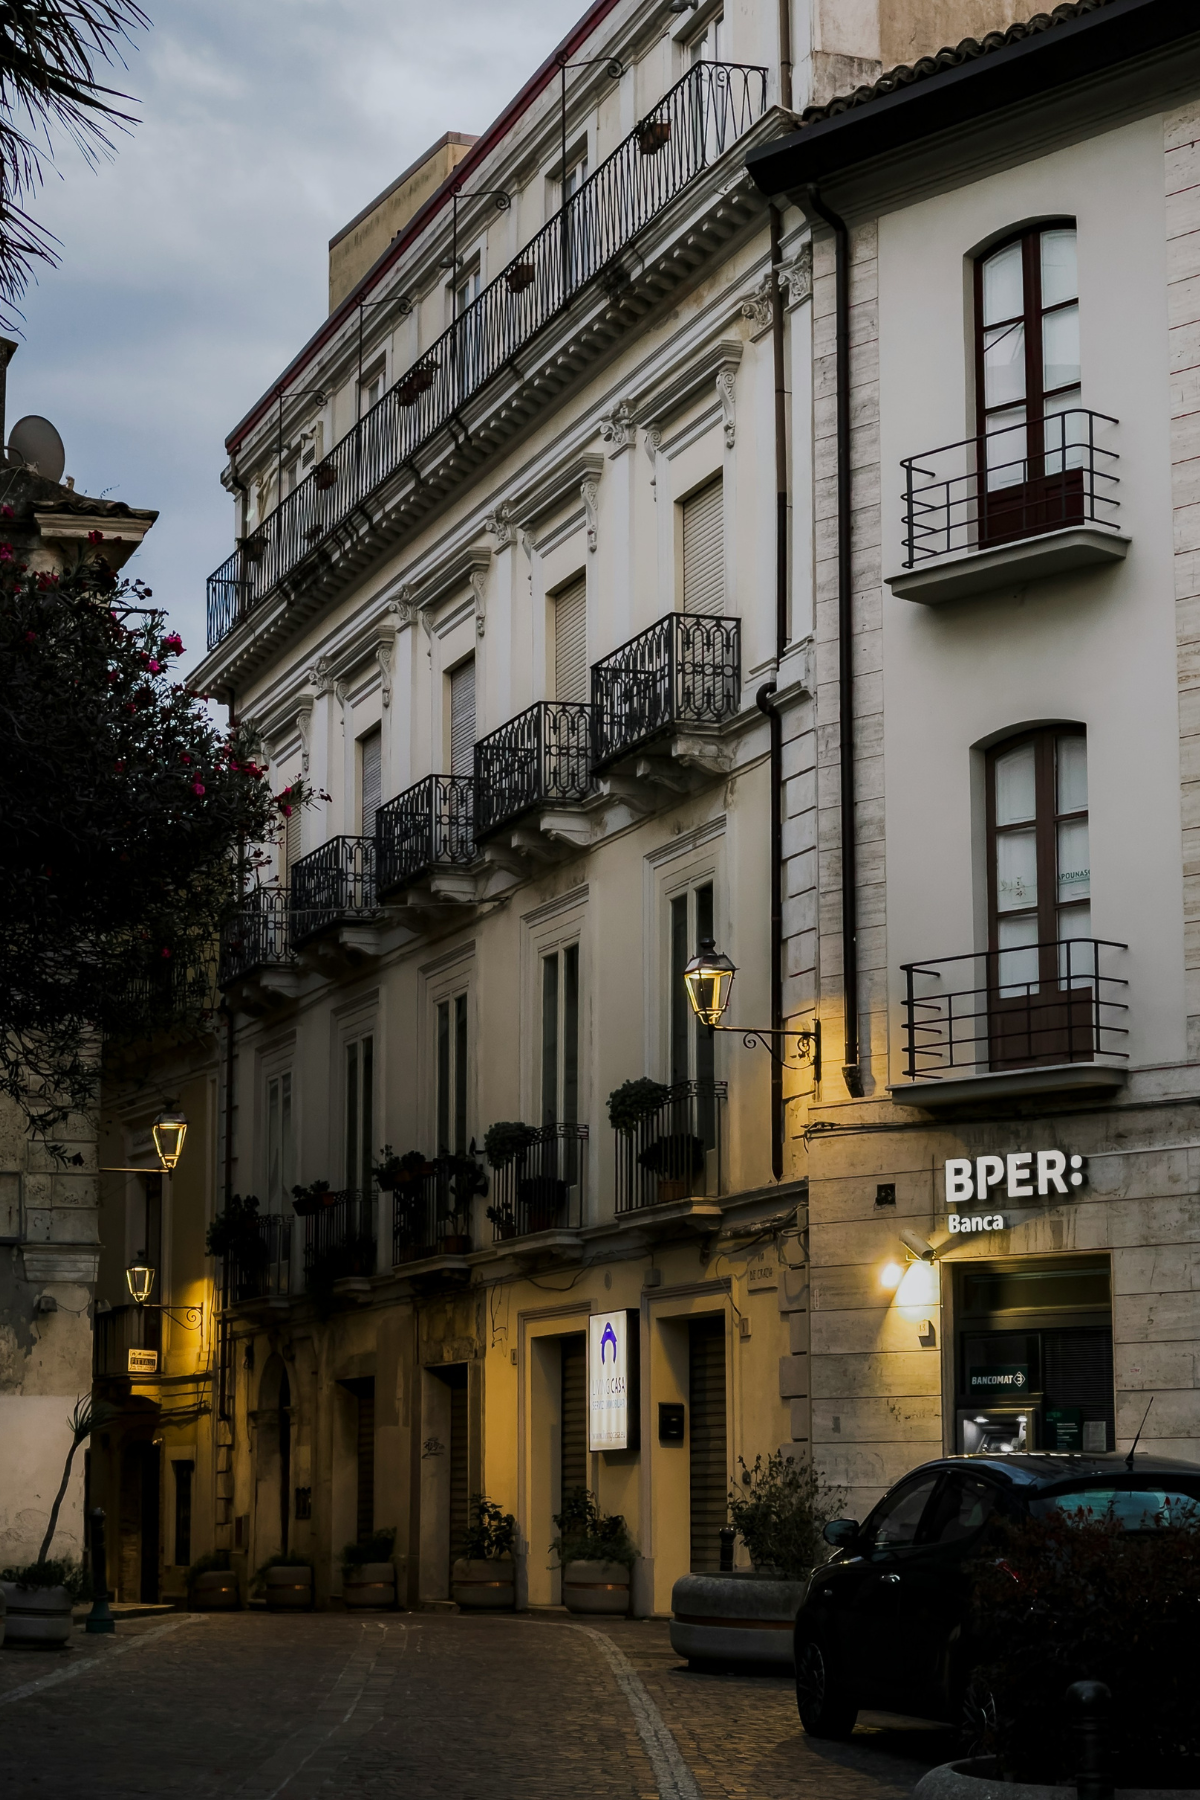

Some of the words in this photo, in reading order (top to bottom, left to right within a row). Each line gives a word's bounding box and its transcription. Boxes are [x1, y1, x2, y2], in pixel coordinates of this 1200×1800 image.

[945, 1150, 1082, 1202] BPER:
[949, 1214, 1004, 1233] Banca
[971, 1375, 1013, 1385] BANCOMAT
